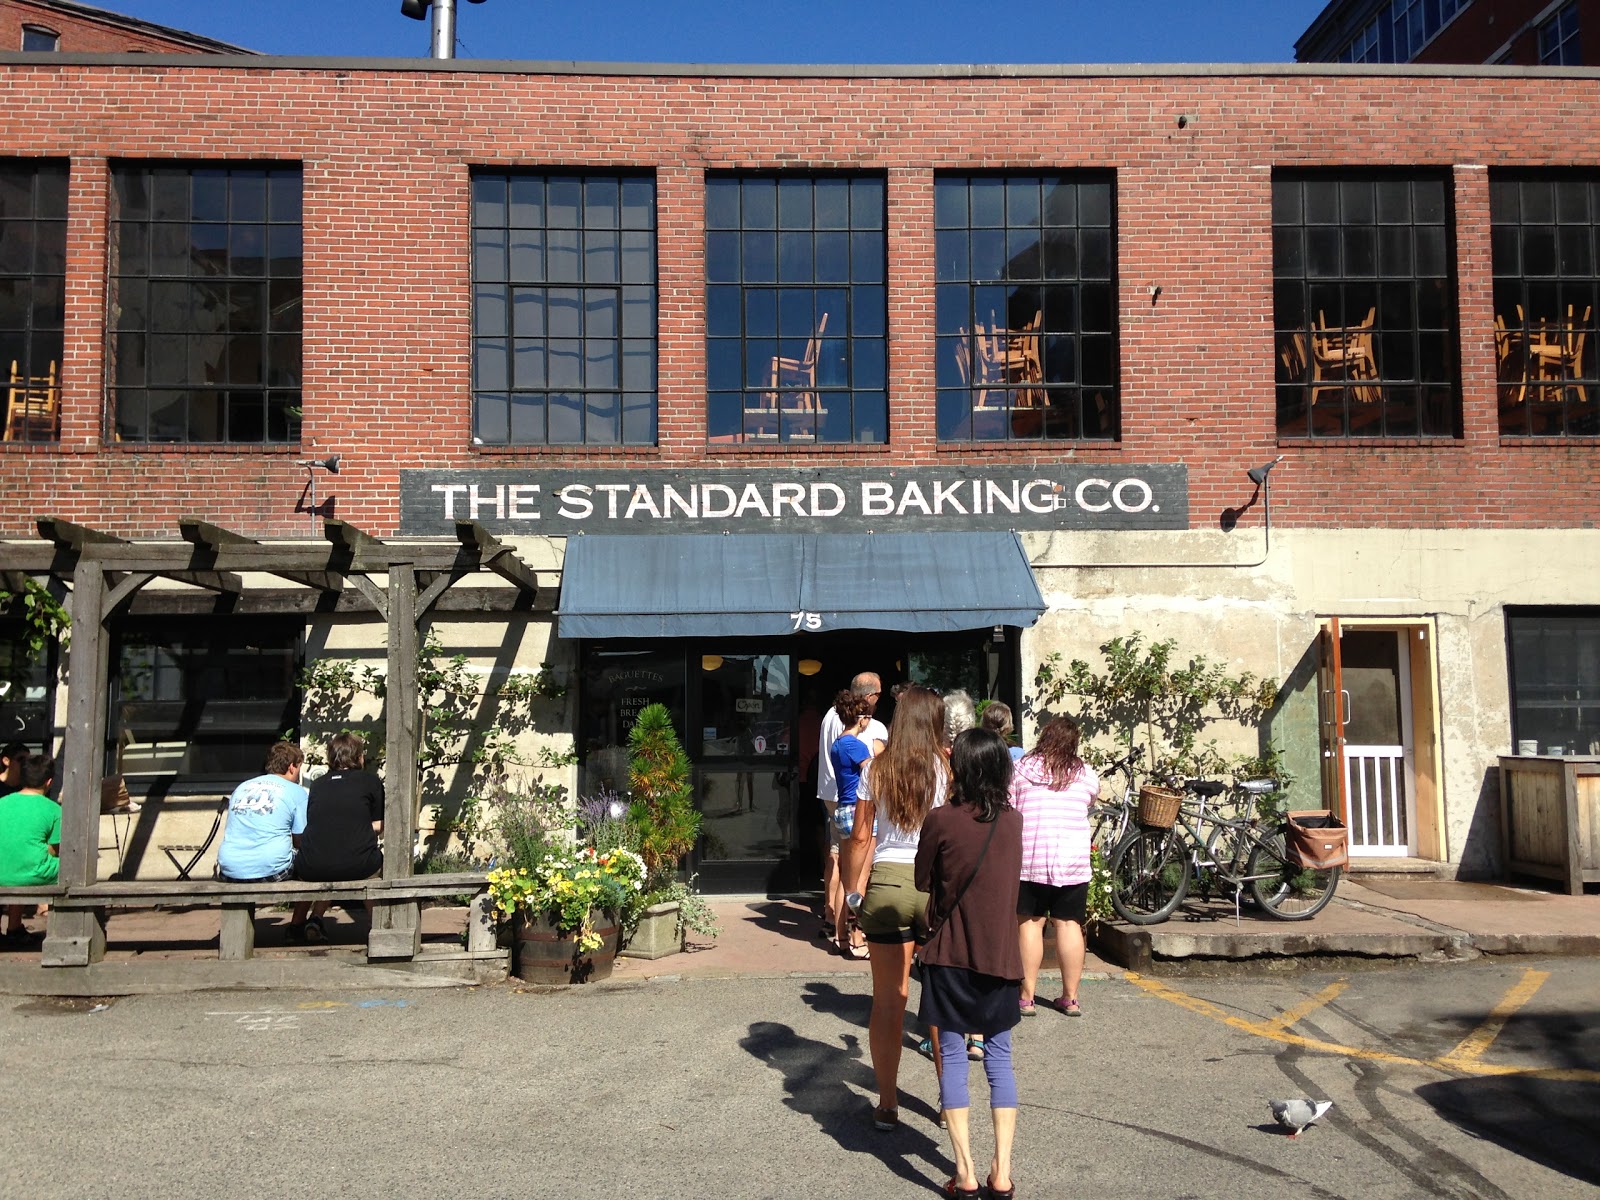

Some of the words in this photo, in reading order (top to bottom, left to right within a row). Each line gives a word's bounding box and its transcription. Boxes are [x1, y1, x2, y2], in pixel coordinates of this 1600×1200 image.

[430, 483, 541, 520] THE
[557, 482, 846, 519] STANDARD
[861, 478, 1059, 516] BAKING
[1075, 477, 1161, 513] CO.
[790, 611, 822, 630] 75
[608, 670, 663, 683] BAGUETTES
[621, 697, 650, 706] FRESH
